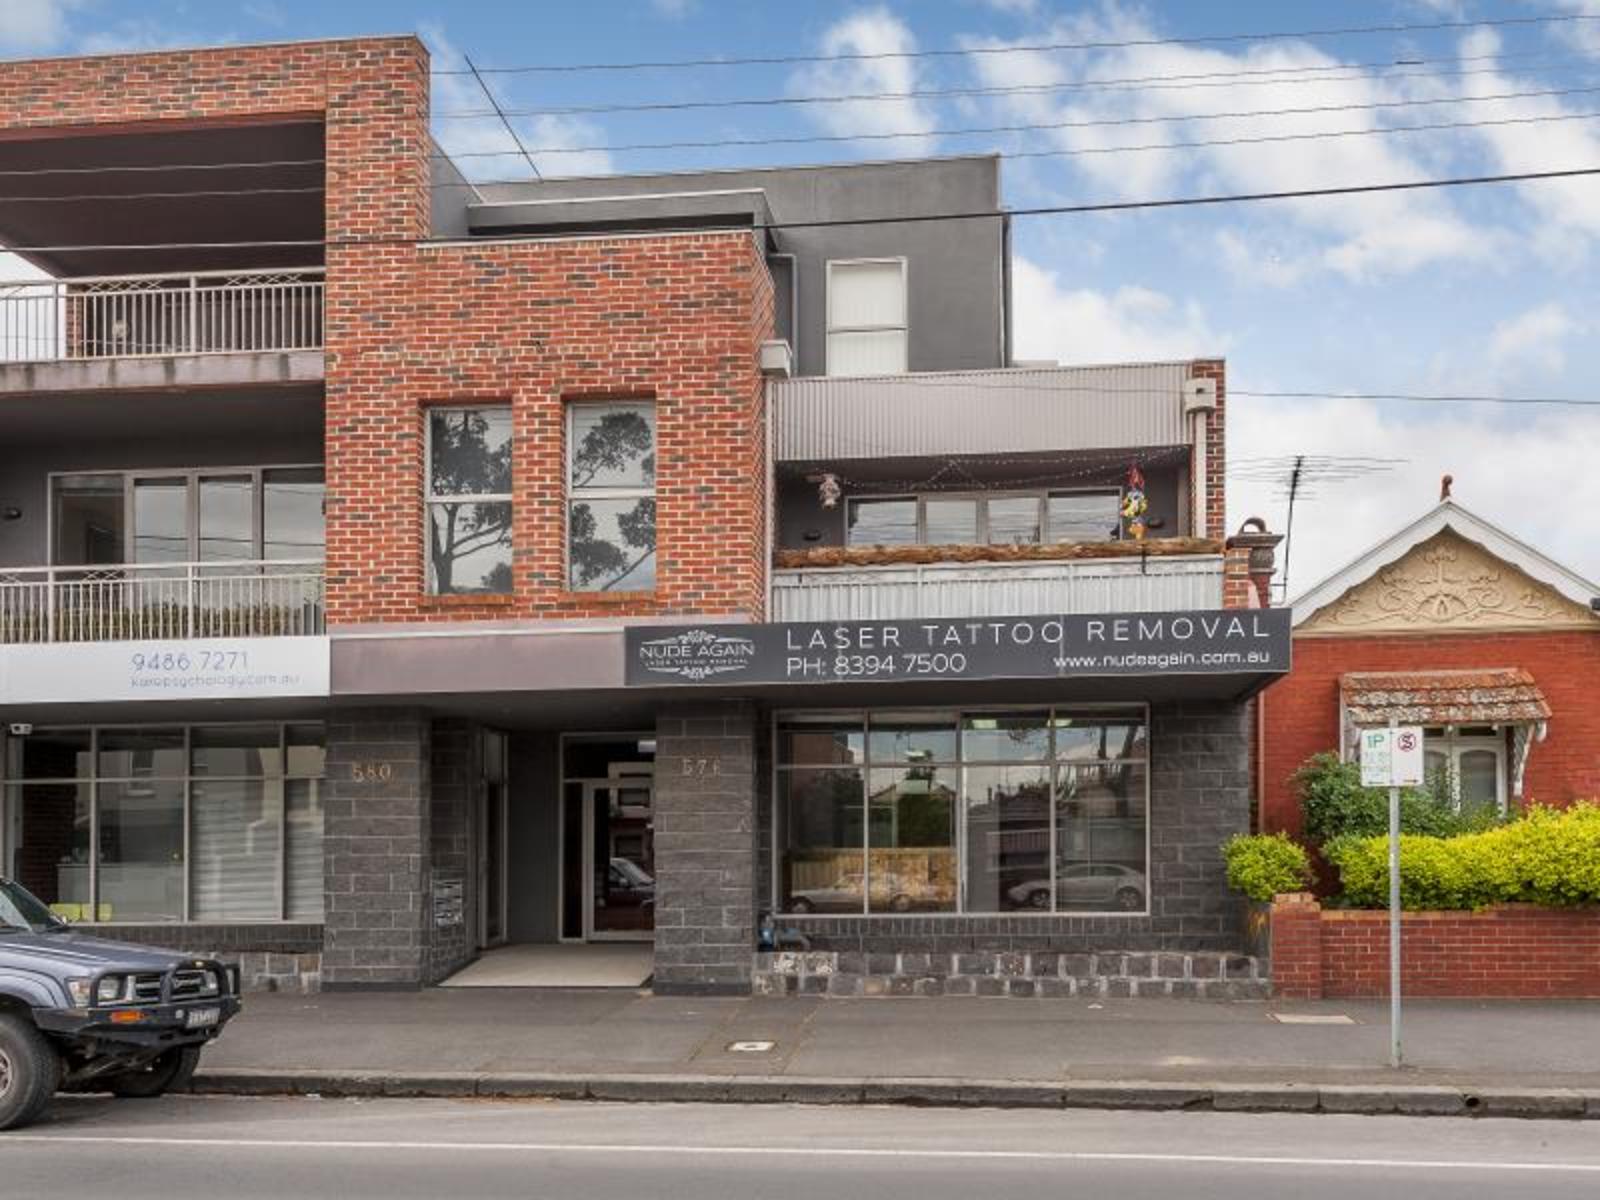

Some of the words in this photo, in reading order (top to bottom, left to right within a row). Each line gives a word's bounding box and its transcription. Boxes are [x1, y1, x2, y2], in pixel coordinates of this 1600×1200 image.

[786, 626, 900, 650] LASER
[920, 621, 1064, 646] TATTOO
[1086, 616, 1271, 642] REMOVAL
[131, 652, 191, 671] 9486
[200, 650, 249, 670] 7271
[639, 645, 692, 658] NUDE
[697, 644, 756, 657] AGAIN
[1052, 650, 1270, 669] www.nudeagain.com.au
[786, 656, 827, 677] PH:
[833, 654, 897, 676] 8394
[902, 652, 967, 673] 7500
